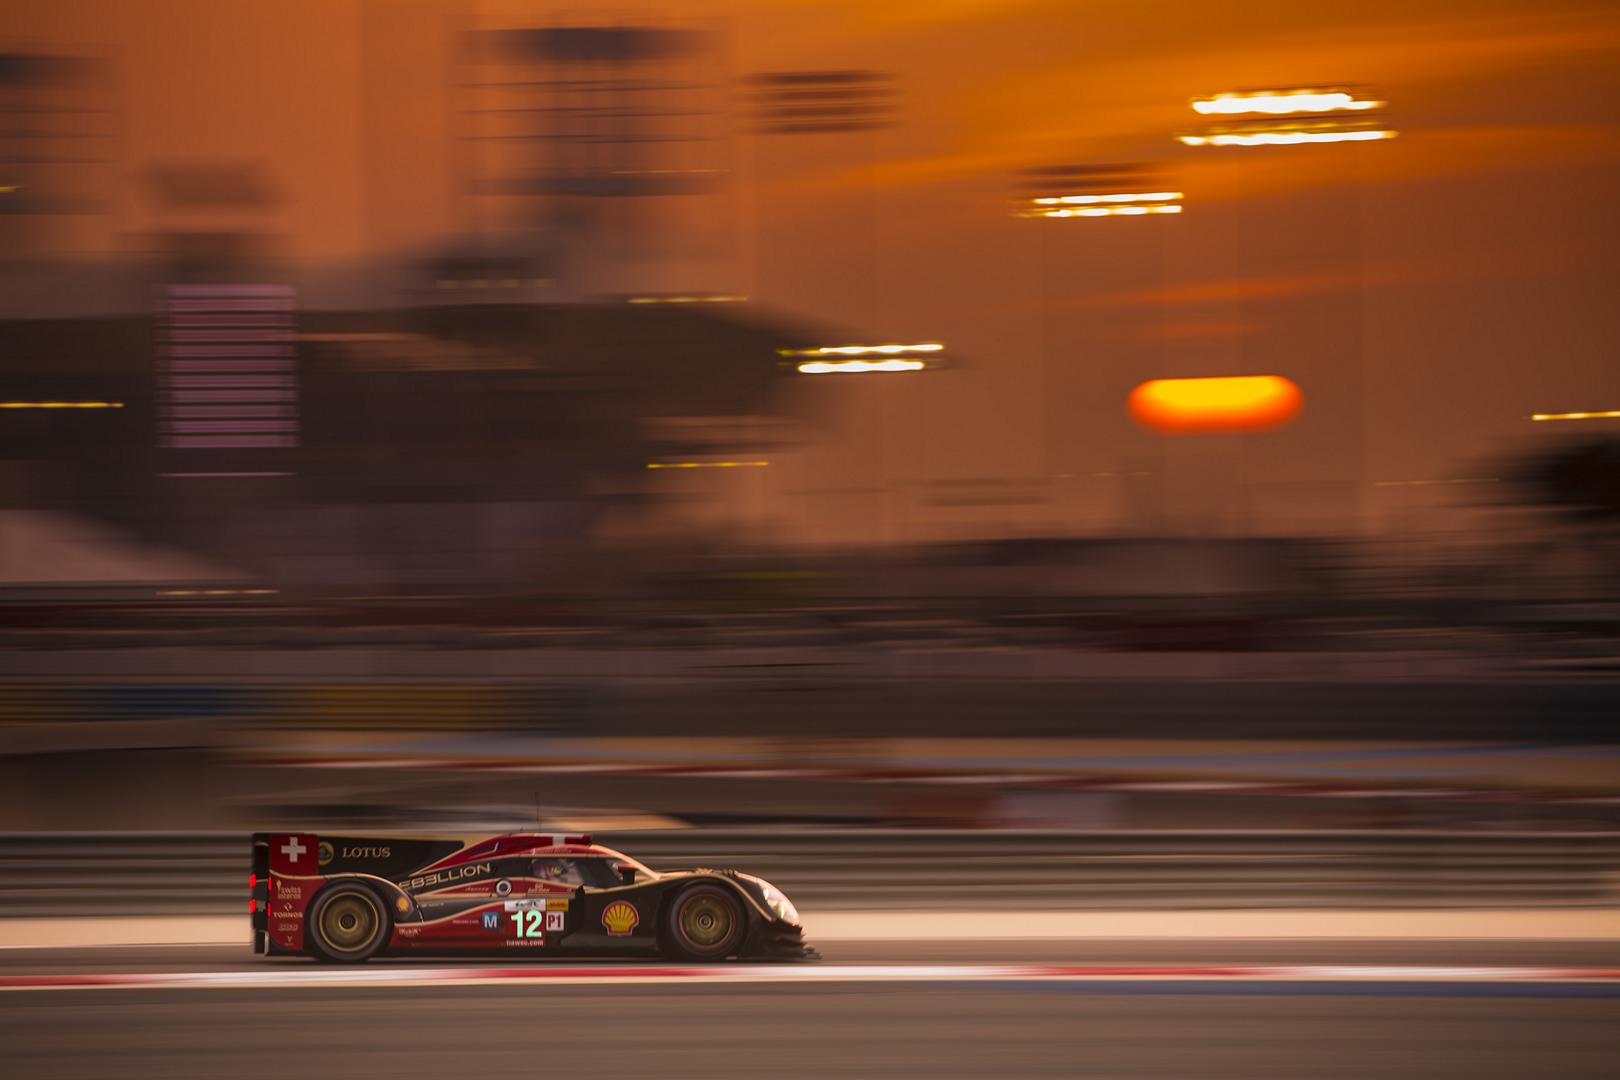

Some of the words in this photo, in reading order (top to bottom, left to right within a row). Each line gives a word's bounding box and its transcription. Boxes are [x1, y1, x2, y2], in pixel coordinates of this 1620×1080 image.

[342, 847, 391, 858] LOTUS
[398, 863, 491, 889] EBELLION
[484, 915, 497, 928] M
[511, 910, 542, 938] 12
[547, 913, 561, 928] P1
